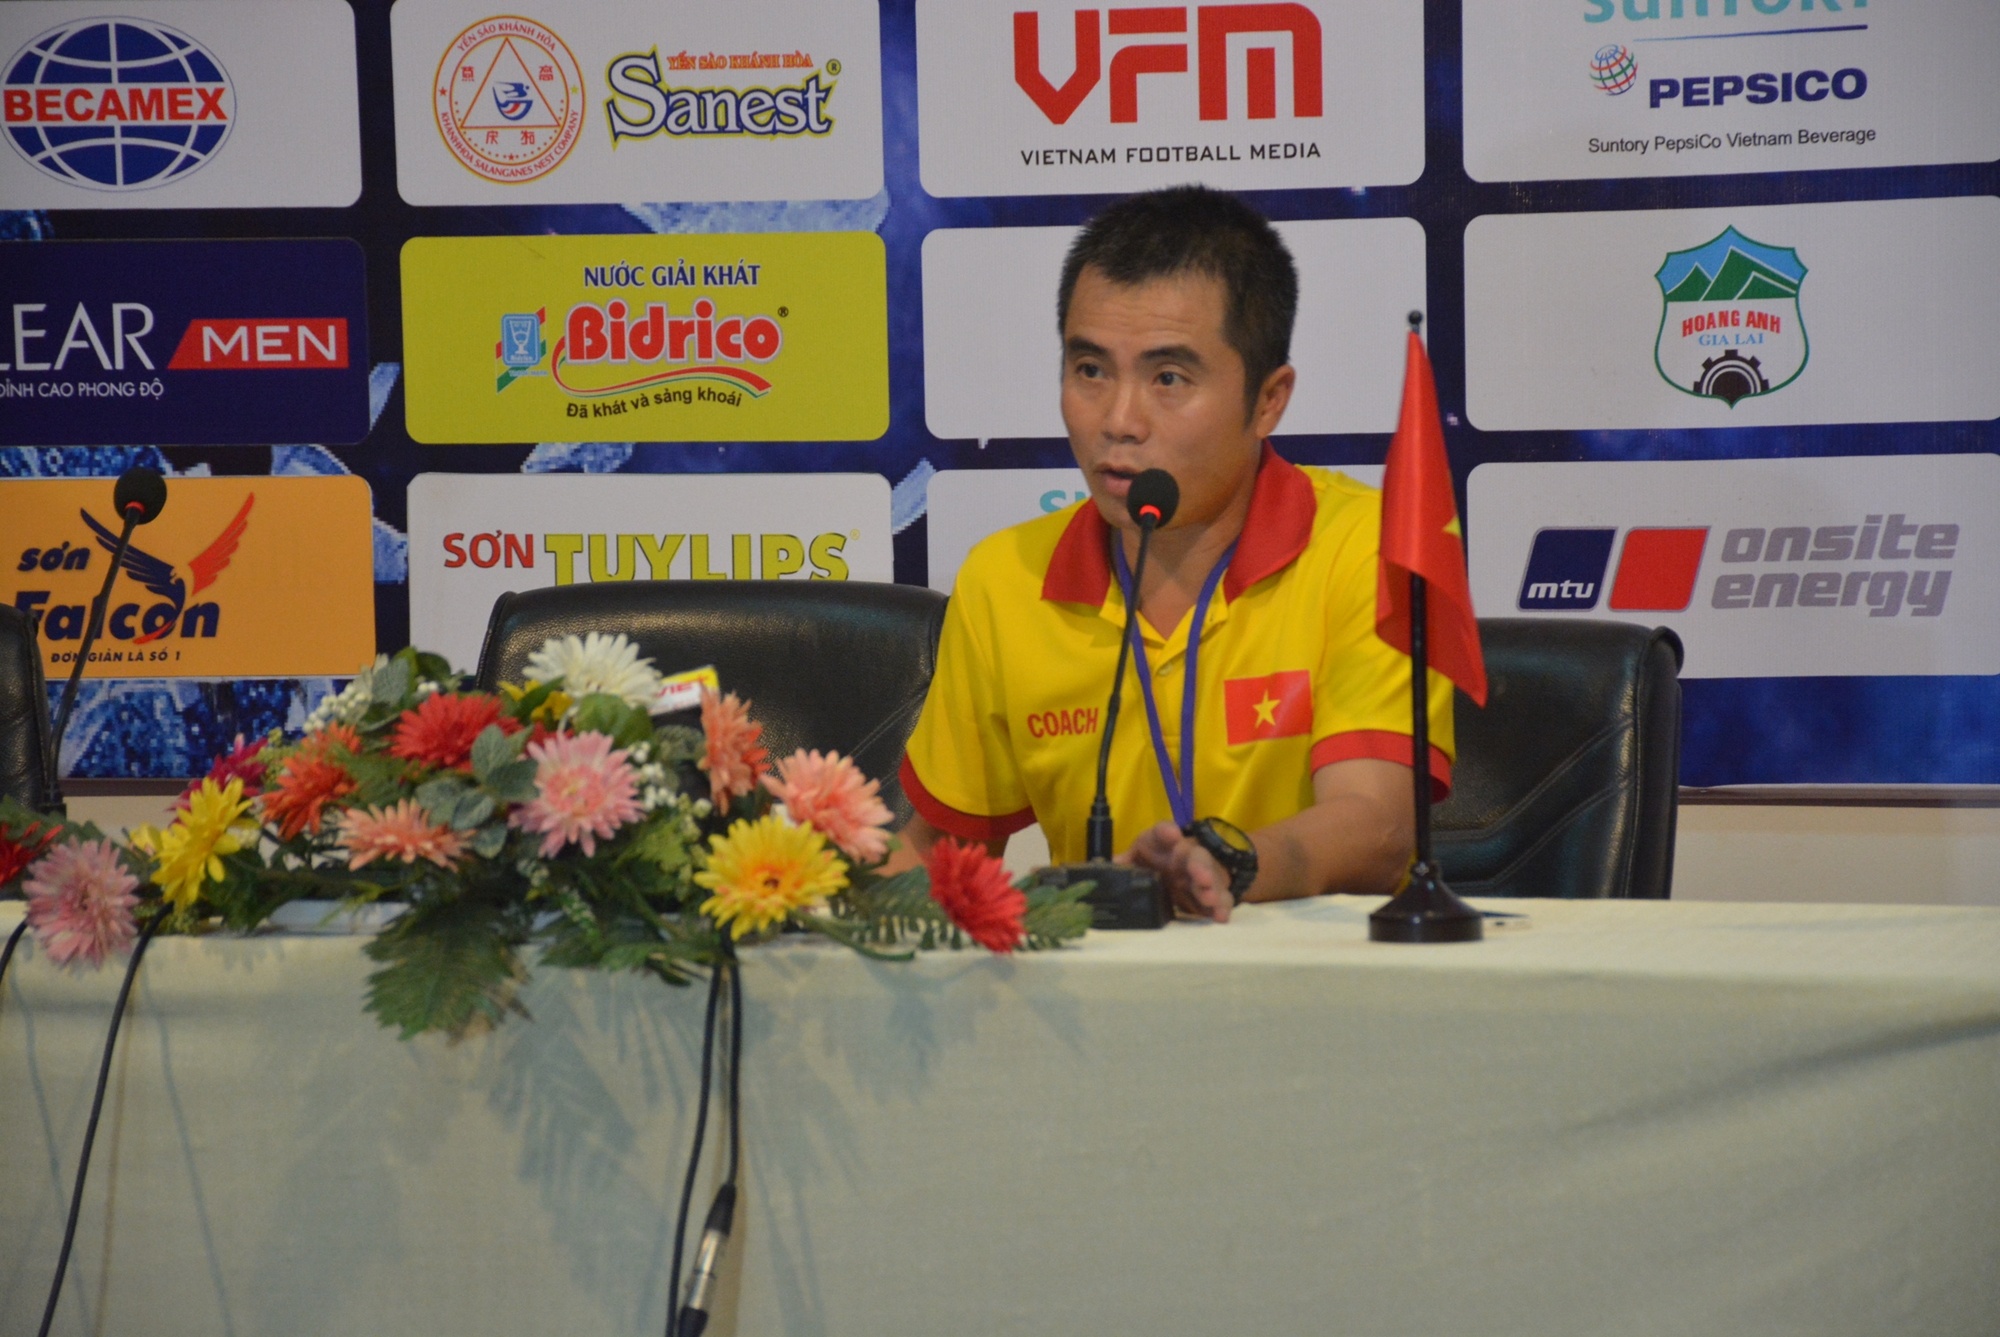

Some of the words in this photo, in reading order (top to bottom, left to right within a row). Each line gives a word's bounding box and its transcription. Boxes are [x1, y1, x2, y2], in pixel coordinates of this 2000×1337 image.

[667, 50, 696, 70] YẾN
[698, 51, 727, 69] SÀO
[729, 51, 780, 69] KHÁNH
[783, 50, 813, 68] HÒA
[1014, 2, 1323, 125] VFM
[607, 50, 833, 142] Sanest
[1649, 68, 1868, 108] PEPSICO
[3, 87, 228, 122] BECAMEX
[475, 159, 534, 177] SALANGANES
[534, 154, 556, 172] NEST
[554, 110, 579, 156] COMPANY
[1021, 148, 1117, 166] VIETNAM
[1126, 145, 1241, 163] FOOTBALL
[1250, 143, 1321, 160] MEDIA
[1588, 138, 1649, 155] Suntory
[1654, 134, 1722, 152] PepsiCo
[1726, 130, 1793, 148] Vietnam
[1798, 128, 1877, 146] Beverage
[584, 261, 645, 287] NƯỚC
[652, 259, 696, 286] GIẢI
[703, 260, 761, 285] KHÁT
[0, 302, 155, 371] EAR
[203, 325, 336, 362] MEN
[567, 299, 781, 363] Bidrico
[1682, 310, 1740, 337] HOANG
[1746, 311, 1781, 334] ANH
[1698, 334, 1729, 346] GIA
[1735, 333, 1765, 345] LAI
[38, 381, 74, 397] CAO
[78, 381, 135, 397] PHONG
[139, 377, 164, 400] ĐỘ
[567, 402, 588, 419] Đã
[593, 399, 628, 418] khát
[632, 392, 651, 410] và
[653, 387, 693, 406] sảng
[697, 386, 743, 407] khoái
[1720, 514, 1960, 563] onsite
[17, 541, 91, 572] sơn
[443, 530, 534, 568] SƠN
[545, 532, 849, 585] TUYLIPS
[1527, 580, 1594, 599] mtu
[1711, 570, 1953, 617] energy
[150, 647, 169, 661] SỐ
[175, 651, 181, 661] 1
[1027, 707, 1099, 739] COACH
